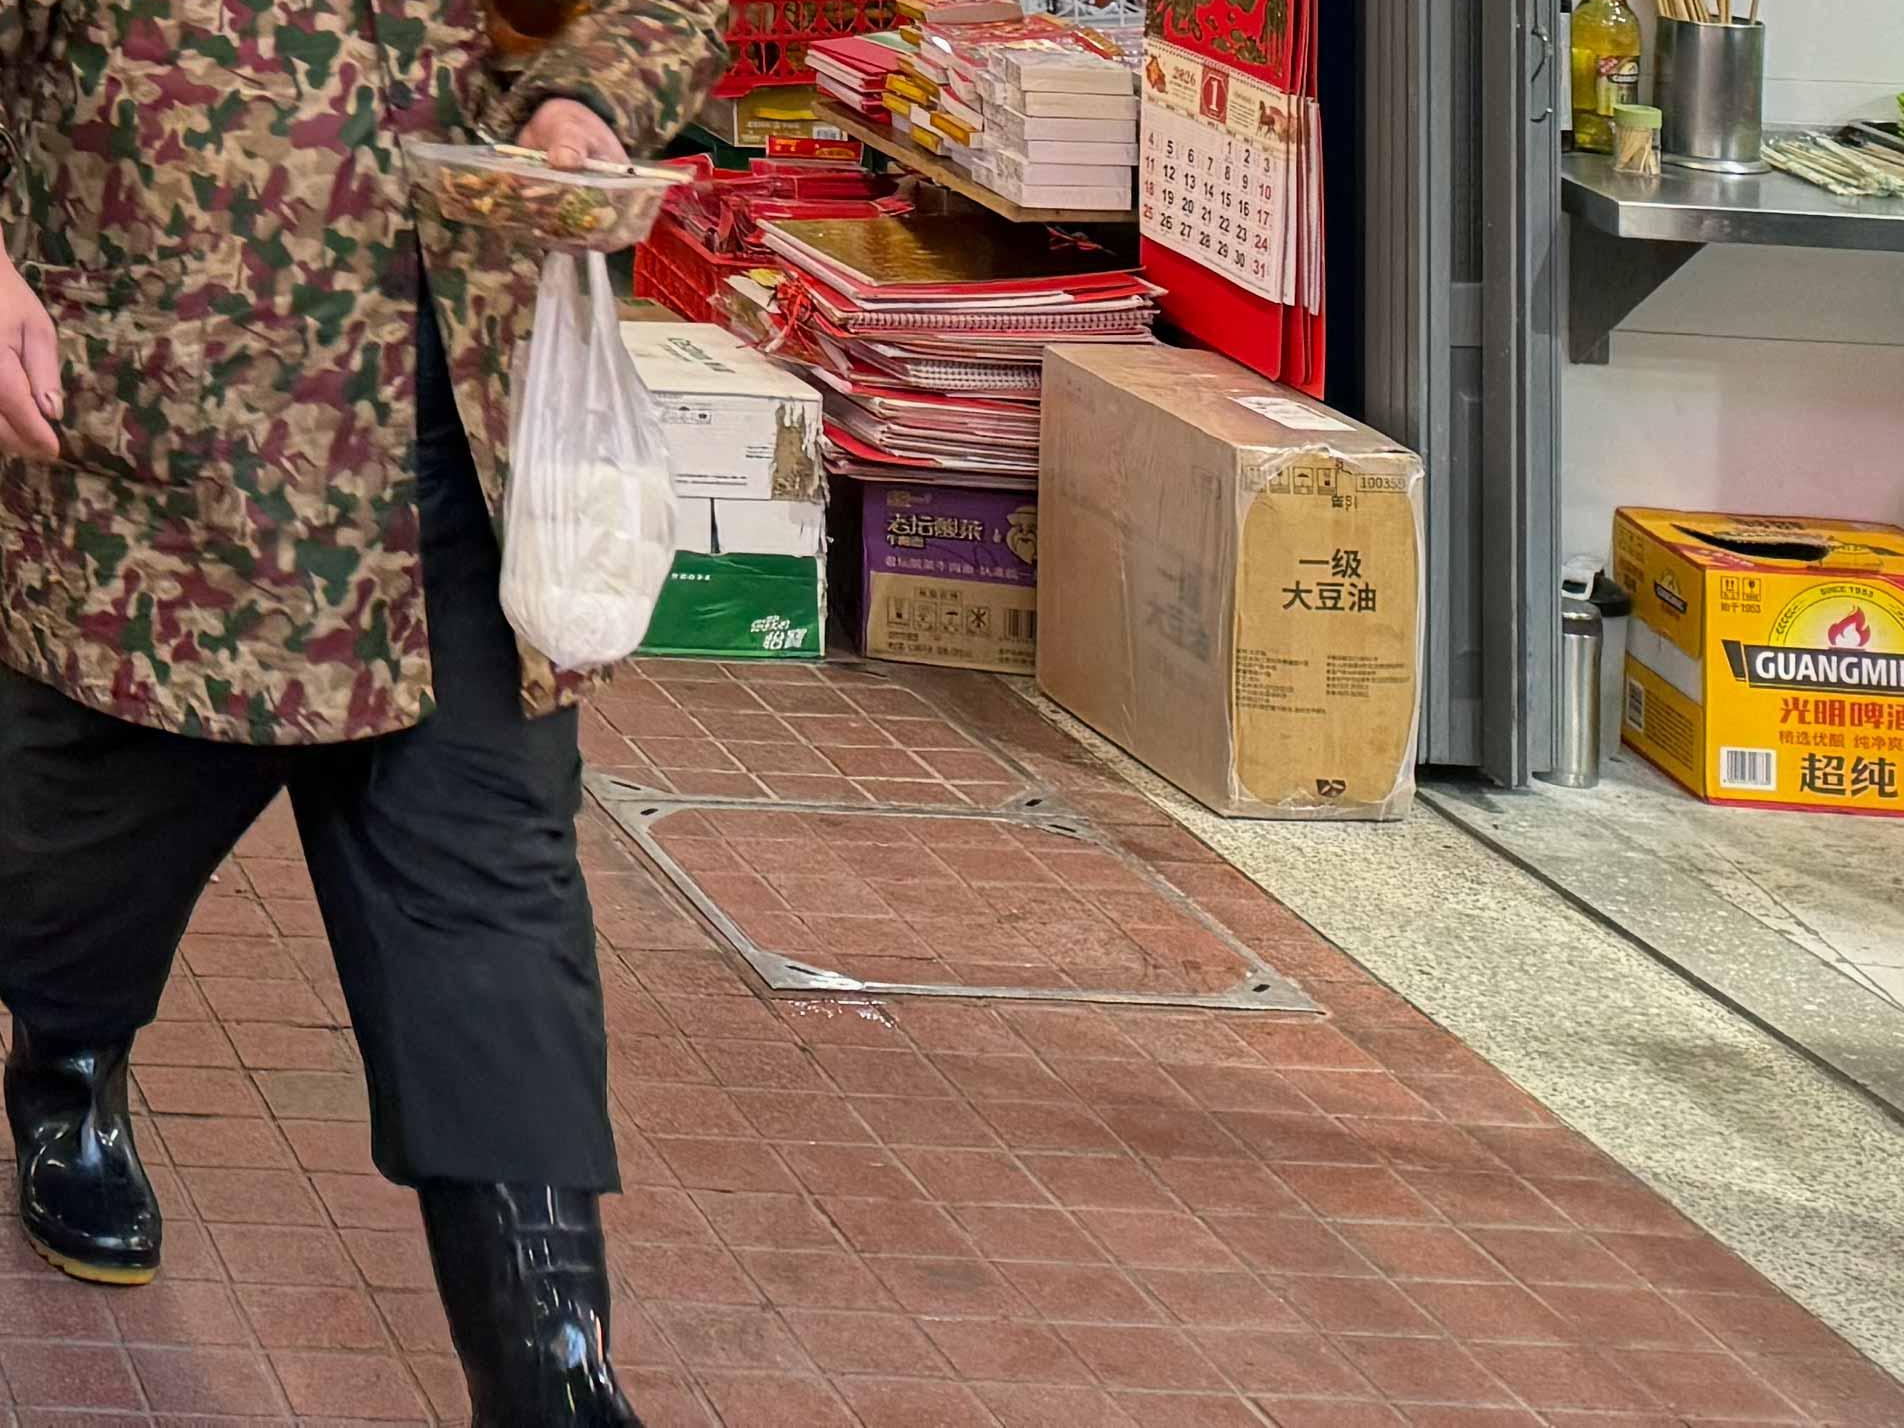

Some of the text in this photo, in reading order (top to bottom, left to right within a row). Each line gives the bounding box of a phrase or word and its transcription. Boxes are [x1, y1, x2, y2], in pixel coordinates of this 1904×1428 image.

[1210, 79, 1219, 112] 1
[1148, 132, 1272, 201] 4 5 6 7 8 9 10
[1227, 141, 1271, 173] 1 2 3
[1145, 155, 1270, 226] 11 12 13 14 15 16 17
[1144, 180, 1269, 252] 18 19 20 21 22 23 24
[1143, 204, 1265, 278] 25 26 27 28 29 30 31
[1298, 548, 1362, 579] 一级
[1281, 580, 1377, 613] 大豆油
[1849, 586, 1874, 599] 1953
[1755, 650, 1904, 688] GUANGMI
[1799, 751, 1899, 800] 超纯
